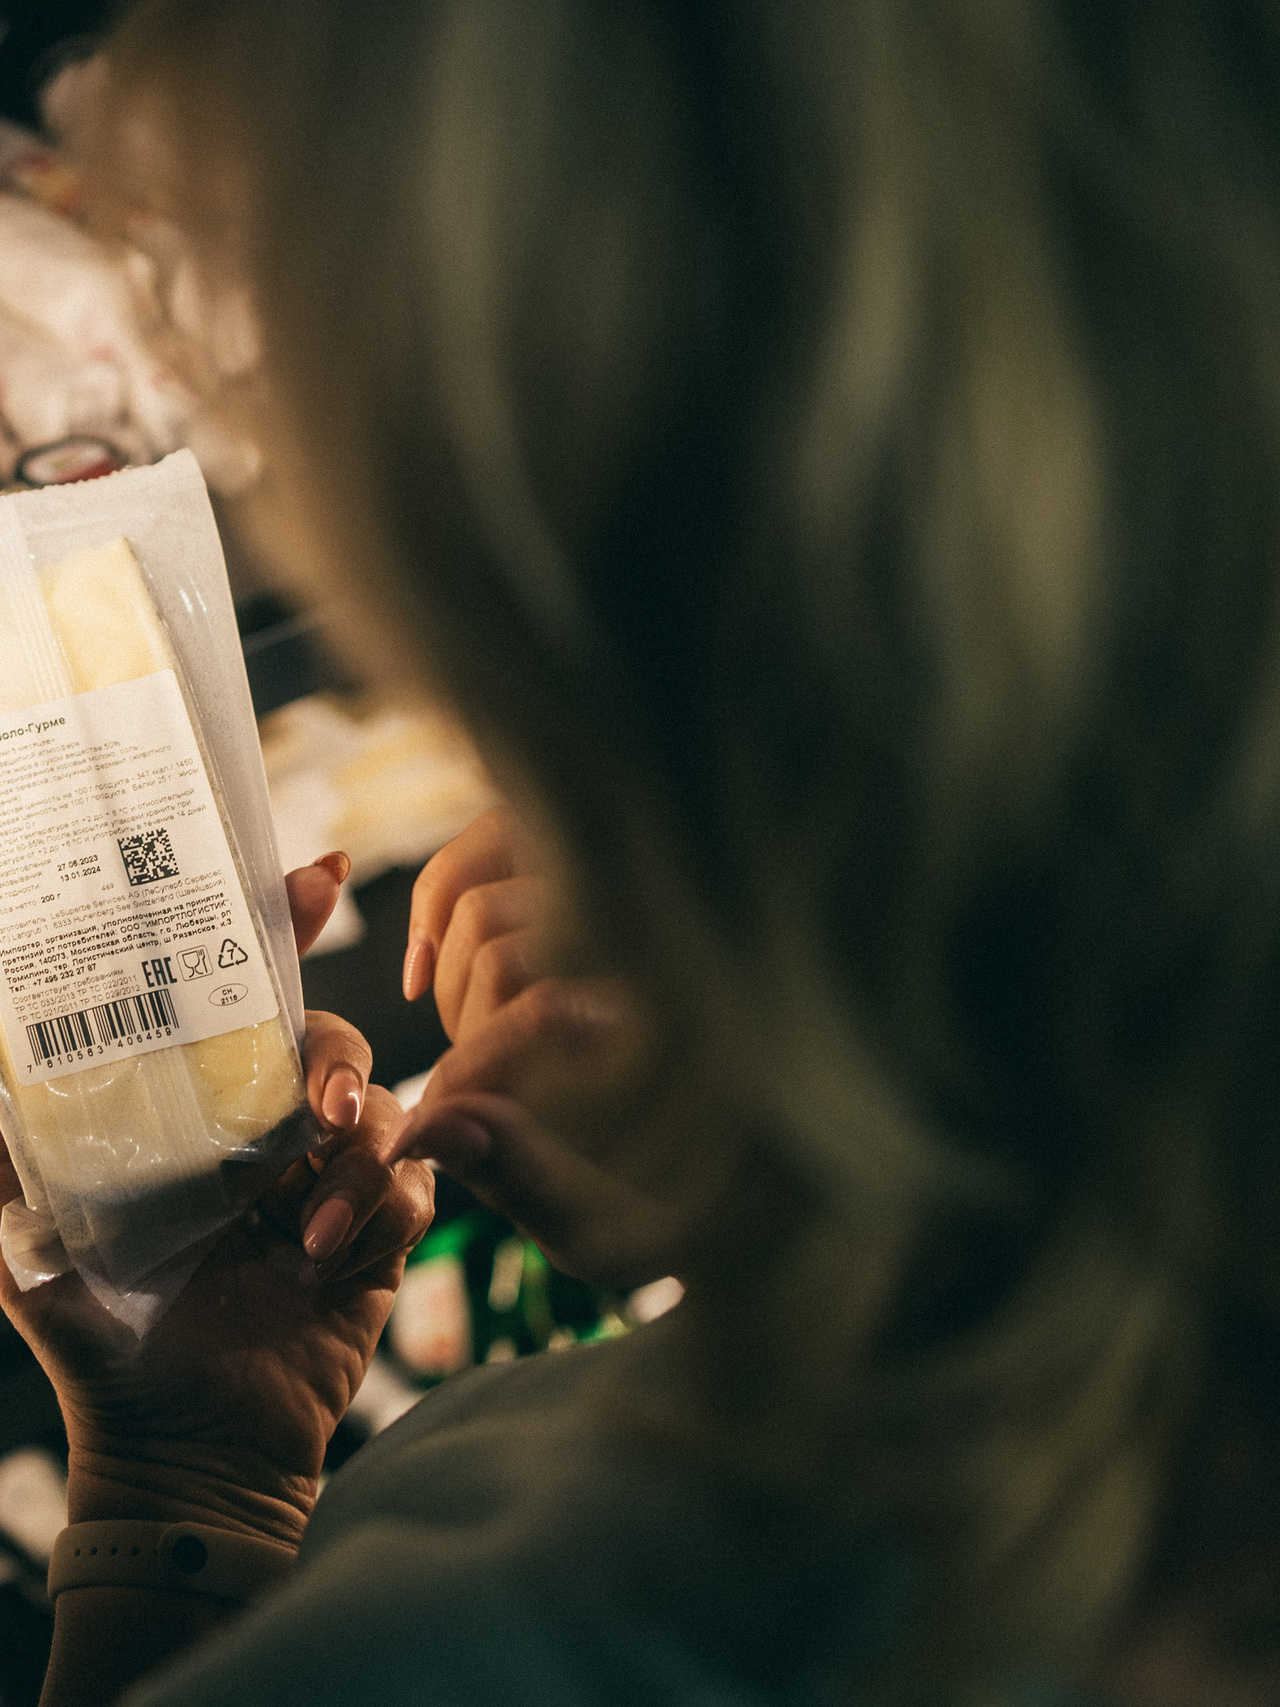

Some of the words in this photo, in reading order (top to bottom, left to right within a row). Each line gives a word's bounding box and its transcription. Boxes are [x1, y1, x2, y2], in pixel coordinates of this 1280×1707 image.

[0, 752, 36, 767] защитной
[38, 741, 80, 757] атмосфере
[13, 764, 32, 773] жира
[41, 756, 64, 766] сухом
[65, 746, 103, 759] веществе
[104, 740, 121, 749] 50%
[53, 765, 92, 782] сычужный
[94, 757, 127, 771] фермент
[56, 759, 87, 771] коровье
[21, 806, 57, 822] ценность
[71, 798, 84, 807] 100
[132, 780, 156, 791] Белки
[157, 776, 167, 784] 25
[178, 768, 200, 778] жиры
[25, 796, 61, 811] ценность
[75, 787, 88, 796] 100
[95, 778, 130, 791] продукта
[136, 771, 150, 780] 347
[152, 767, 169, 776] ккал
[176, 758, 194, 769] 1450
[4, 837, 18, 845] при
[20, 823, 69, 841] температуре
[93, 814, 104, 822] до
[137, 788, 195, 809] относительной
[46, 832, 71, 843] После
[72, 823, 109, 836] вскрытия
[110, 813, 145, 828] упаковки
[145, 805, 176, 817] хранить
[177, 800, 192, 808] при
[49, 845, 59, 853] до
[92, 826, 135, 842] употребить
[143, 815, 174, 828] течение
[176, 810, 185, 818] 14
[187, 804, 207, 817] дней
[0, 859, 52, 878] изготовления
[57, 854, 99, 872] 27.06.2023
[60, 865, 101, 882] 13.01.2024
[40, 893, 55, 903] 200
[50, 904, 91, 920] LeSuperbe
[93, 896, 126, 908] Services
[127, 891, 140, 899] AG
[184, 870, 223, 885] Сервисес
[53, 918, 72, 929] 6333
[115, 904, 131, 912] See
[132, 893, 174, 908] Switzerland
[175, 878, 226, 899] (Швейцария)
[0, 941, 44, 957] Импортер,
[45, 926, 100, 944] организация,
[102, 907, 172, 930] уполномоченная
[186, 892, 224, 908] принятие
[2, 949, 45, 966] претензий
[46, 946, 56, 954] от
[58, 929, 119, 951] потребителей:
[120, 923, 140, 934] ООО
[4, 962, 37, 975] Россия,
[39, 952, 69, 966] 140073,
[70, 939, 120, 957] Московская
[122, 931, 158, 943] область,
[160, 927, 174, 935] г.о.
[175, 914, 219, 930] Люберцы,
[221, 909, 232, 918] рп
[6, 968, 52, 984] Томилино,
[54, 963, 70, 971] тер.
[71, 943, 134, 966] Логистический
[136, 939, 162, 950] центр,
[172, 924, 219, 940] Рязанское,
[9, 983, 31, 994] Тел.:
[33, 978, 42, 986] +7
[44, 974, 59, 984] 495
[60, 969, 74, 979] 232
[76, 966, 86, 975] 27
[87, 963, 97, 971] 87
[12, 984, 71, 1005] Соответствует
[73, 969, 124, 988] требованиям
[15, 1005, 26, 1015] ТР
[27, 1002, 39, 1011] ТС
[40, 991, 76, 1007] 033/2013
[77, 988, 88, 997] ТР
[89, 984, 101, 993] ТС
[102, 974, 137, 990] 022/2011
[17, 1015, 29, 1024] ТР
[30, 1011, 42, 1020] ТС
[43, 1001, 78, 1017] 021/2011
[79, 997, 91, 1007] ТР
[92, 994, 104, 1003] ТС
